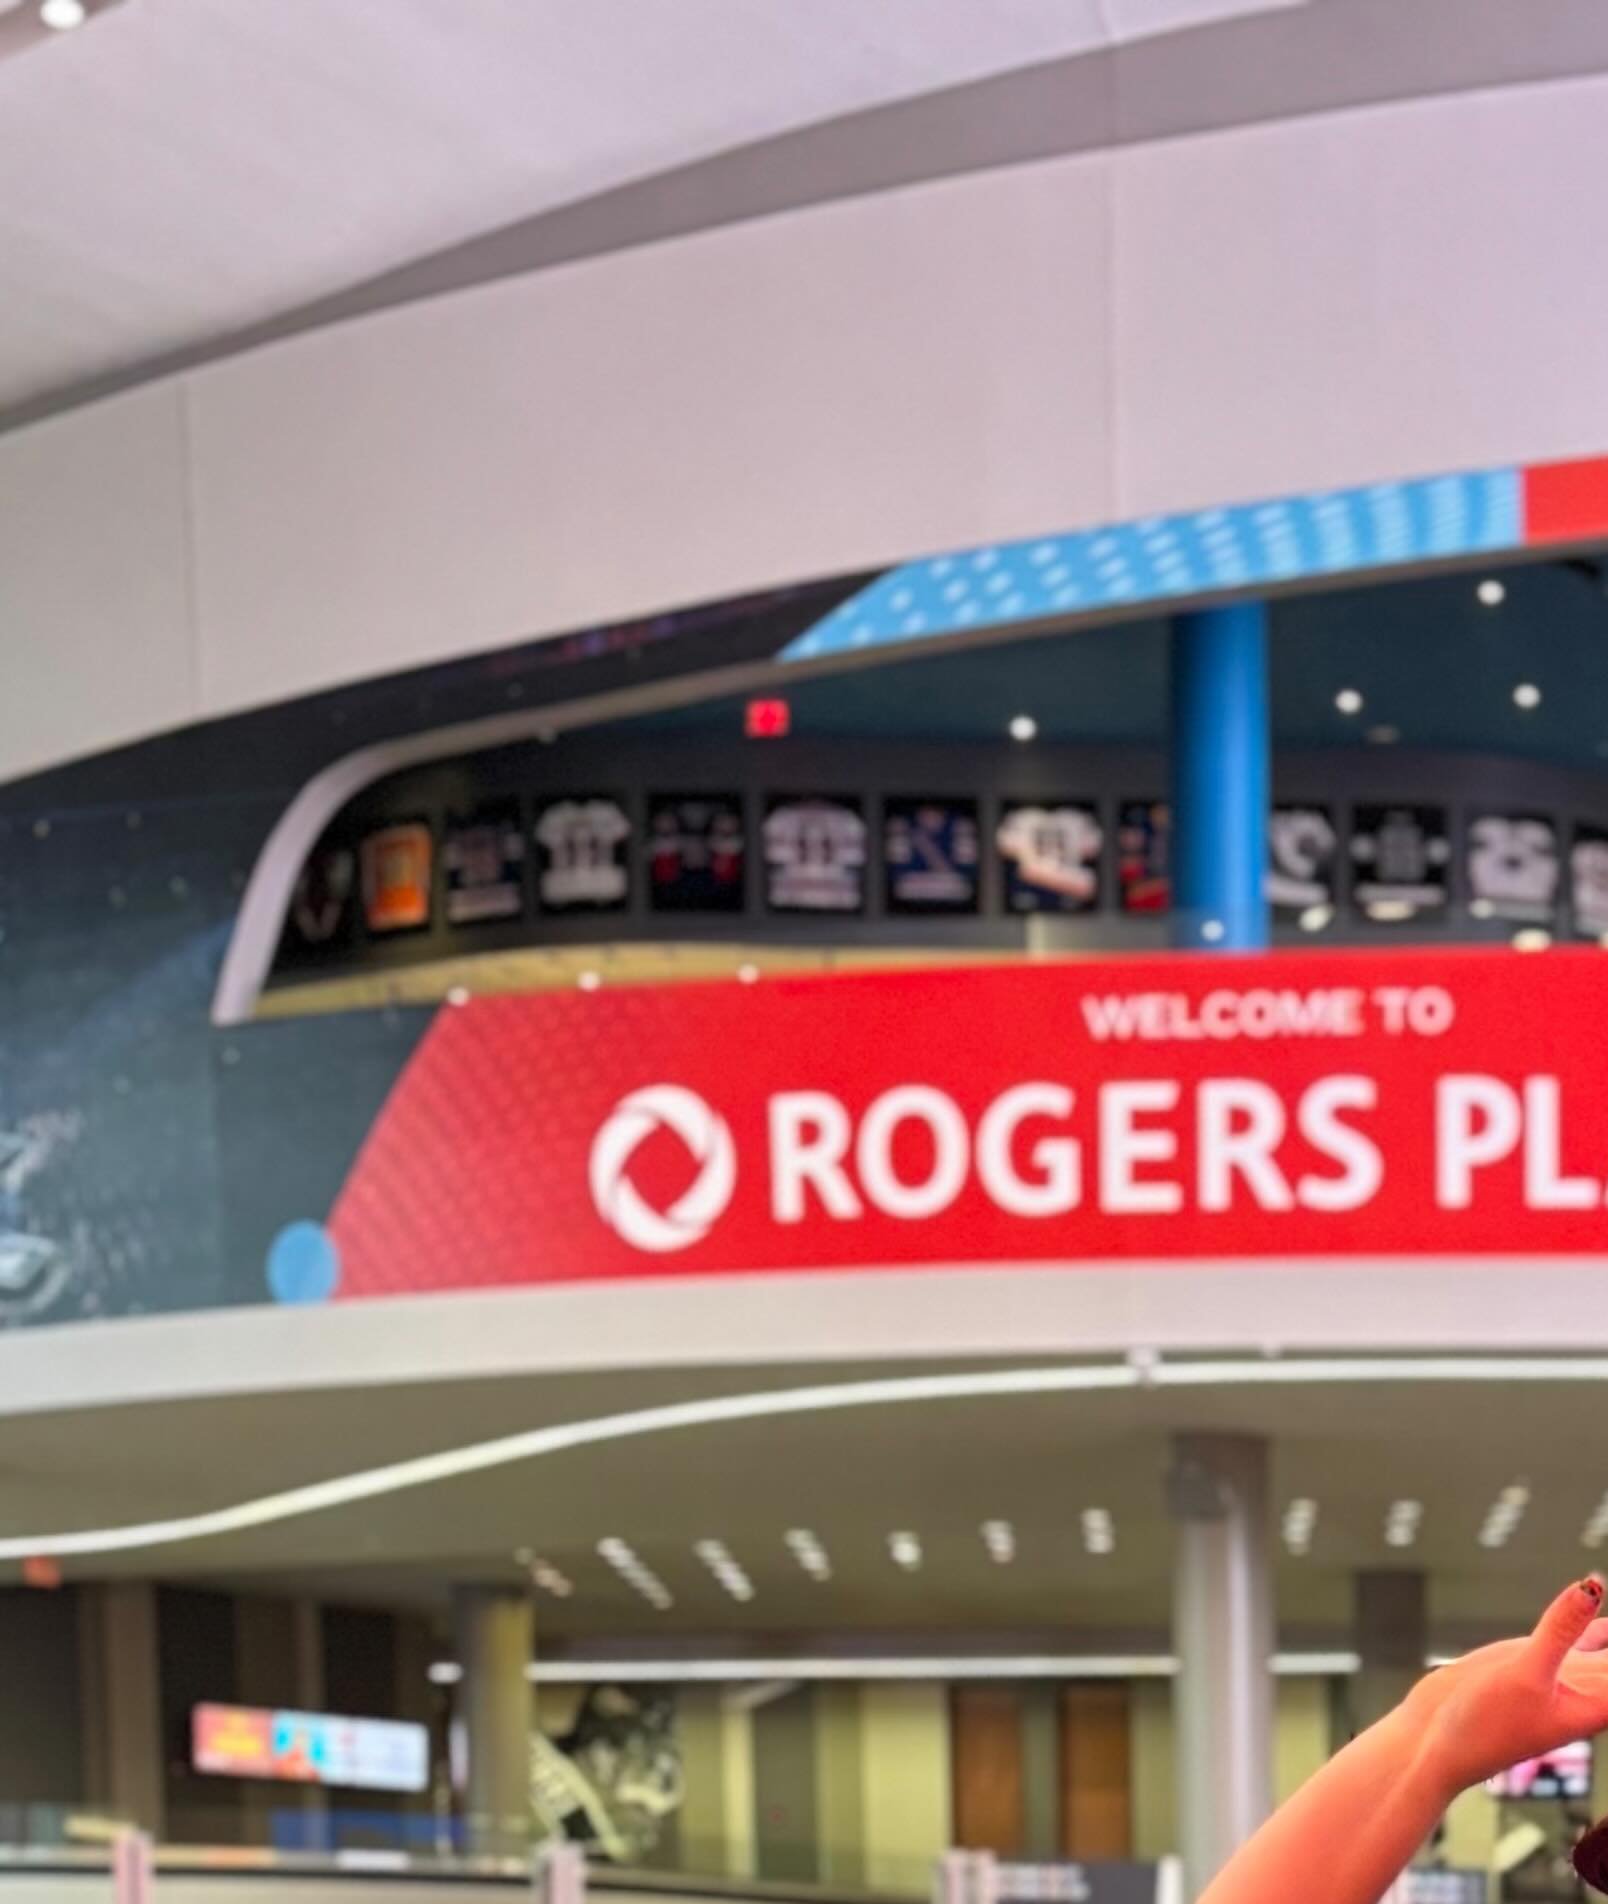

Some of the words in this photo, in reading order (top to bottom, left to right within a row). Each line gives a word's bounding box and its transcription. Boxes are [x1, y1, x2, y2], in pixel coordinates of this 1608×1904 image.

[1081, 988, 1363, 1040] WELCOME
[1375, 986, 1454, 1036] TO
[769, 1076, 1383, 1222] ROGERS
